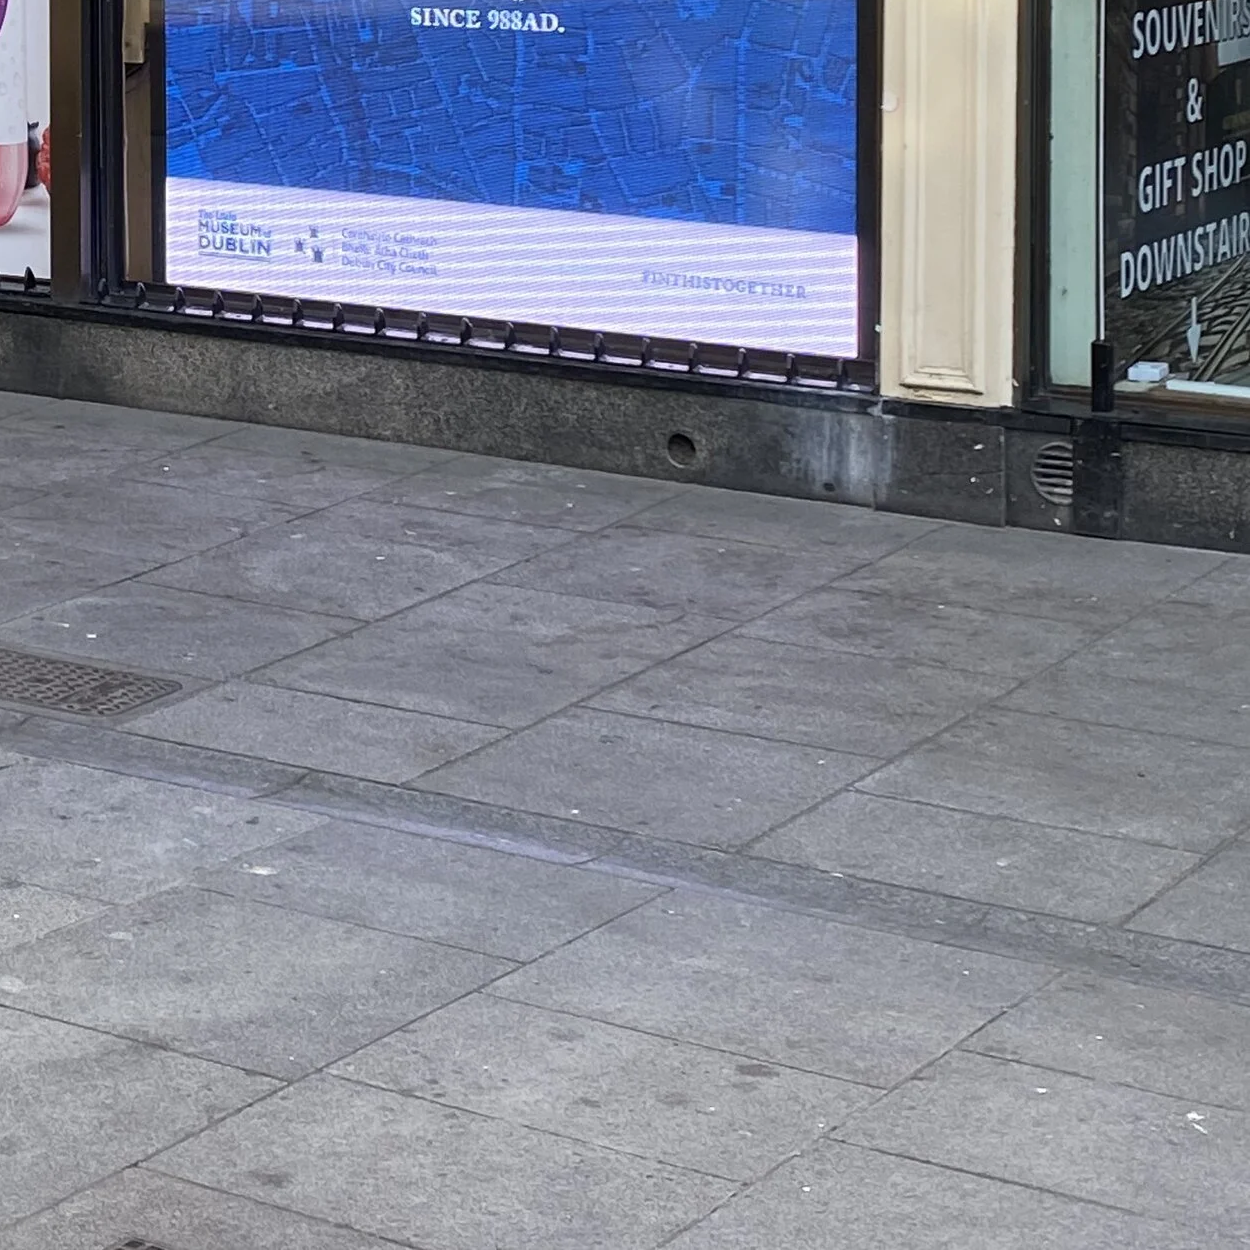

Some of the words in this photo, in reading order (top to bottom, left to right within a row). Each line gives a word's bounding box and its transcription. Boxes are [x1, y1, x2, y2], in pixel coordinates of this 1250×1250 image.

[410, 7, 481, 29] SINCE
[488, 9, 566, 34] 988AD.
[1186, 77, 1204, 123] &
[1138, 157, 1187, 214] GIFT
[1190, 140, 1247, 199] SHOP
[198, 220, 262, 238] MUSEUM
[198, 236, 272, 257] DUBLIN
